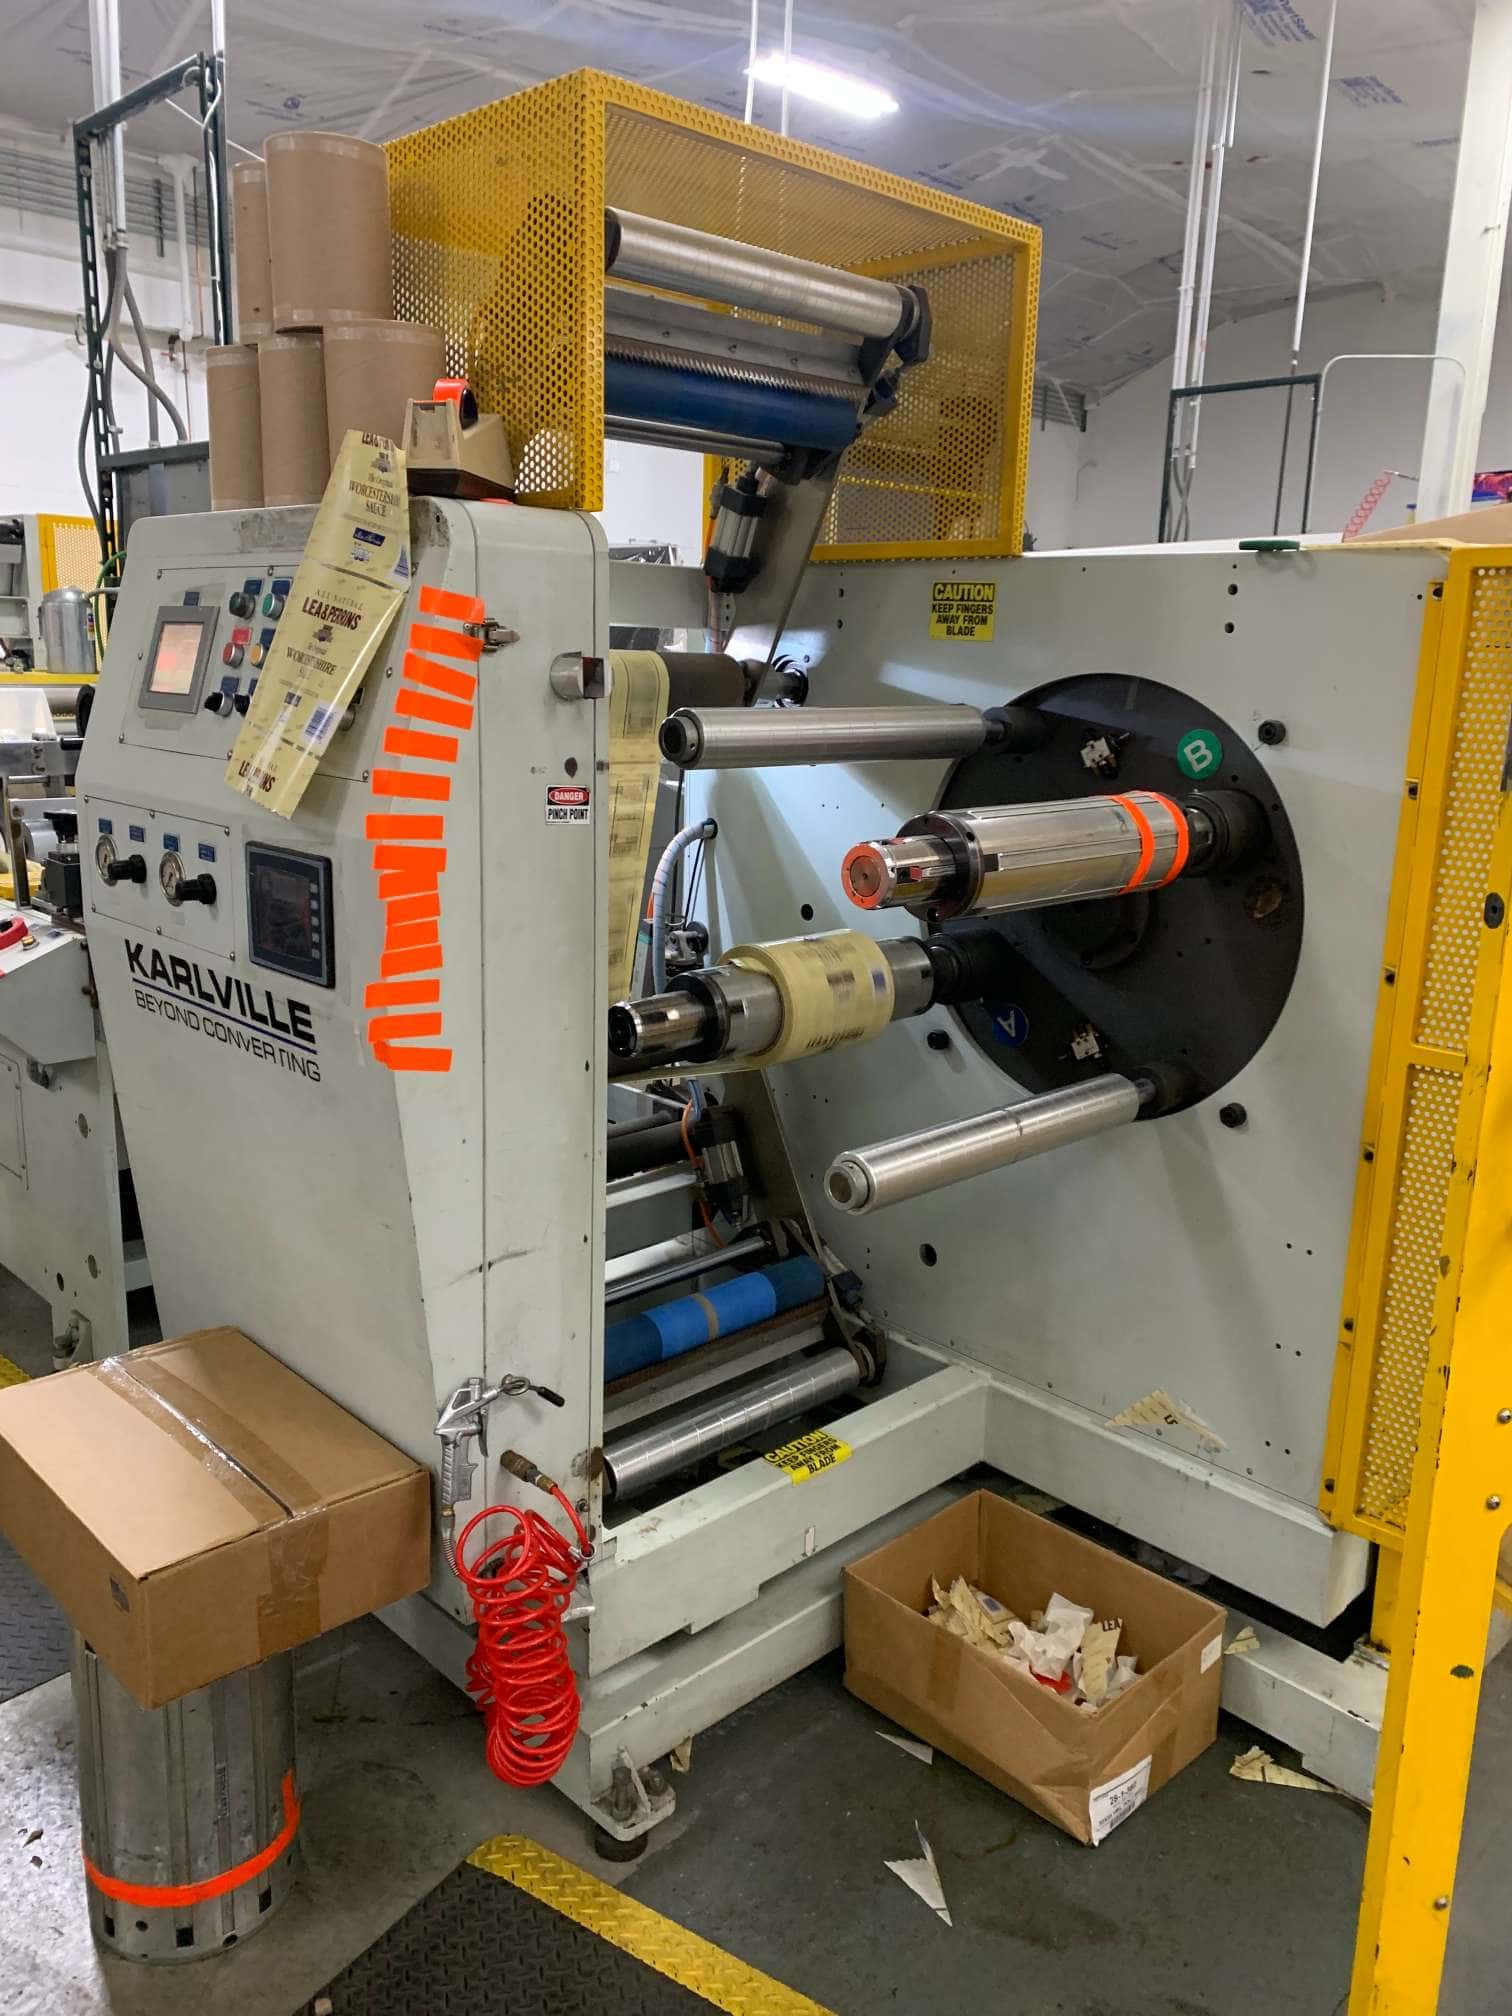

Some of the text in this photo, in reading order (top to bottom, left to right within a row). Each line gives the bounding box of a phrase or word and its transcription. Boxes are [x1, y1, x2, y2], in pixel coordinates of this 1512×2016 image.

[935, 584, 994, 600] CAUTION
[932, 603, 993, 614] KEEP FINGERS
[936, 615, 987, 625] AWAY FROM
[946, 626, 975, 636] BLADE
[1184, 739, 1213, 773] B
[554, 791, 584, 801] DANGER
[548, 808, 589, 820] PINCH POINT
[125, 938, 316, 1045] KARLVILLE
[997, 1010, 1016, 1037] A
[134, 989, 321, 1082] BEYOND CONVERTING
[764, 1429, 828, 1462] CAUTION
[808, 1454, 836, 1474] BLADE
